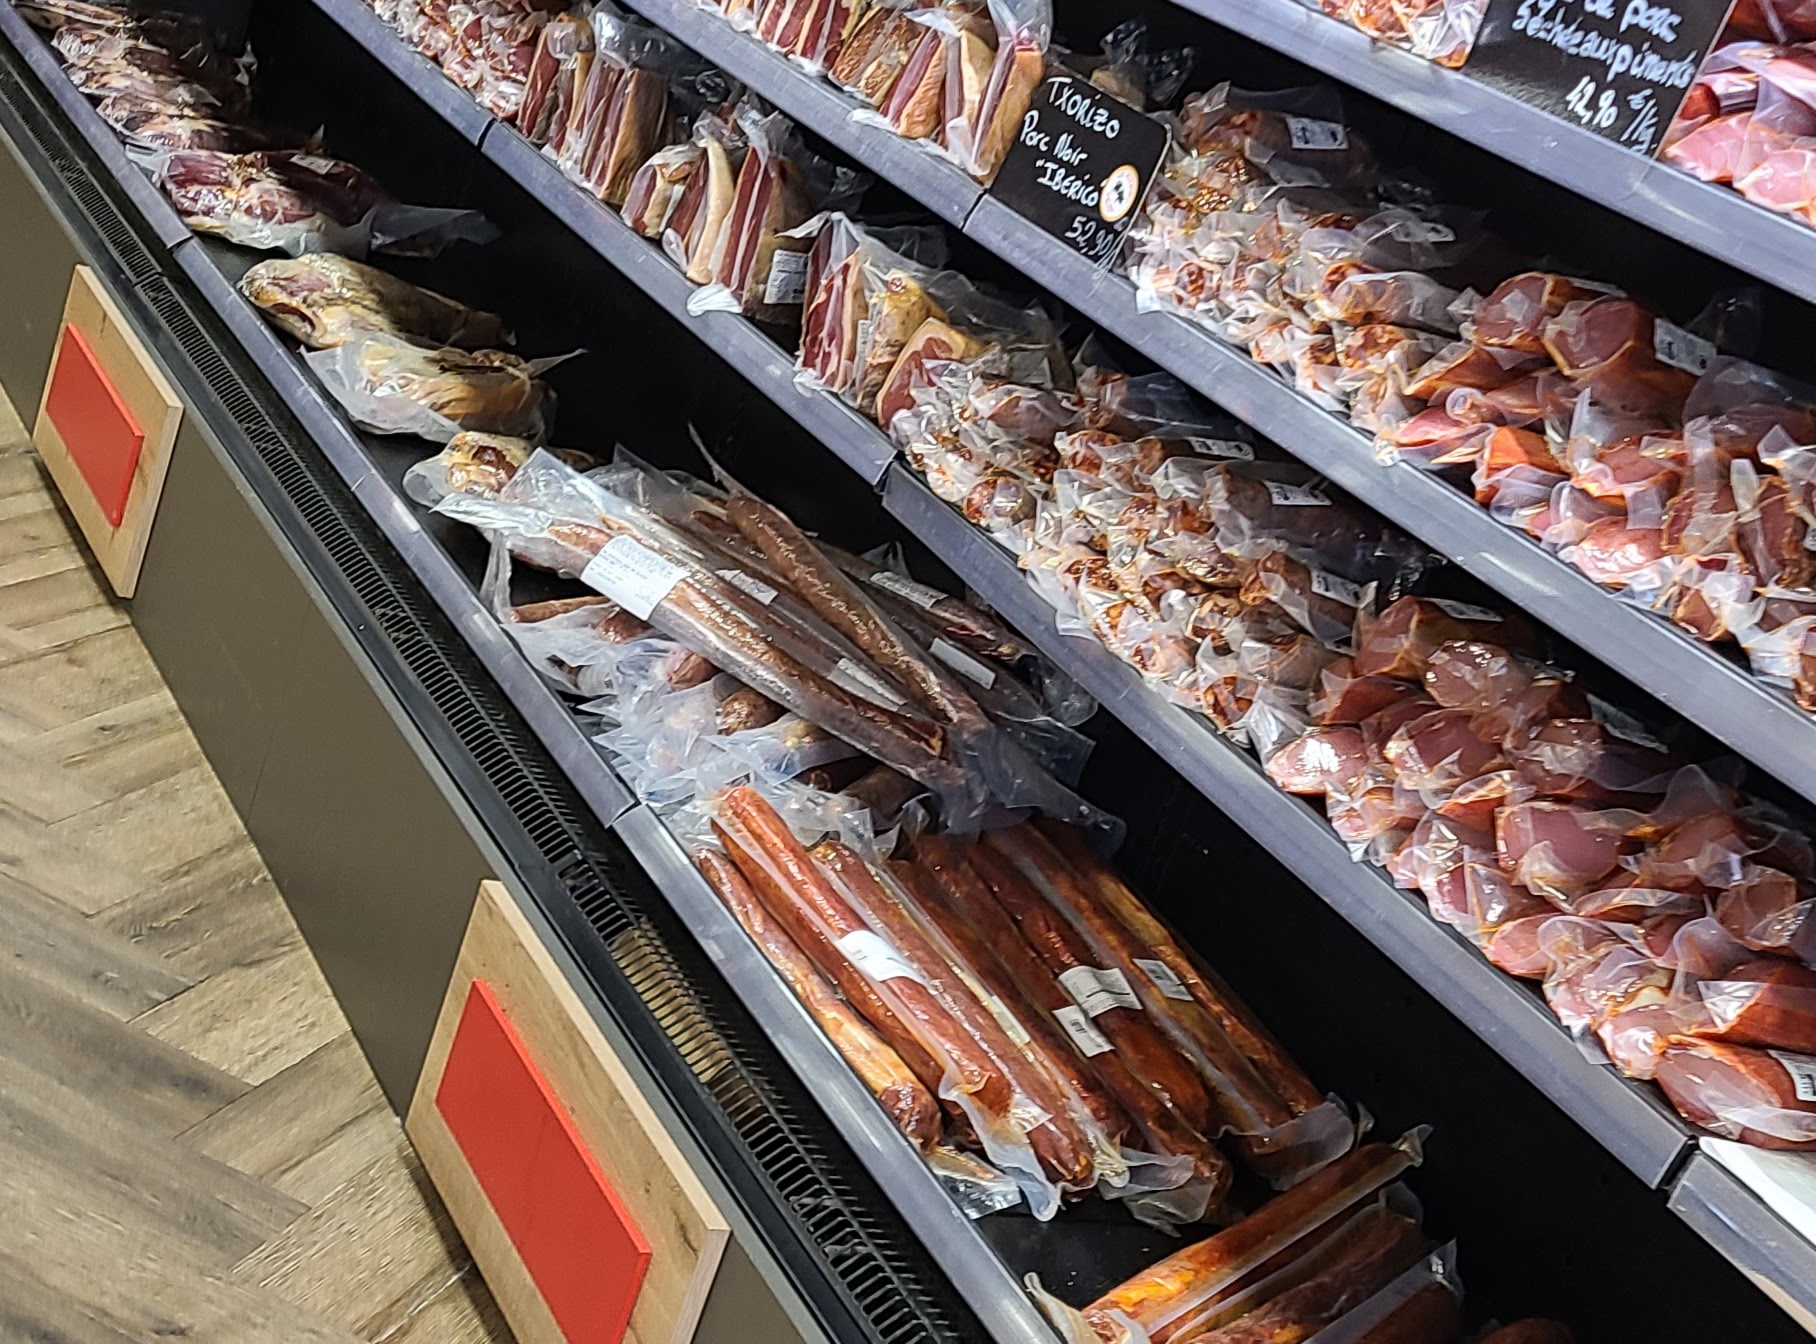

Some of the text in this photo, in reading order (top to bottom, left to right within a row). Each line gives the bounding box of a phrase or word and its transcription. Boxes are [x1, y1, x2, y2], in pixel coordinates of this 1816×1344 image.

[1566, 75, 1618, 129] 42,90
[1020, 110, 1089, 167] Porc Noir
